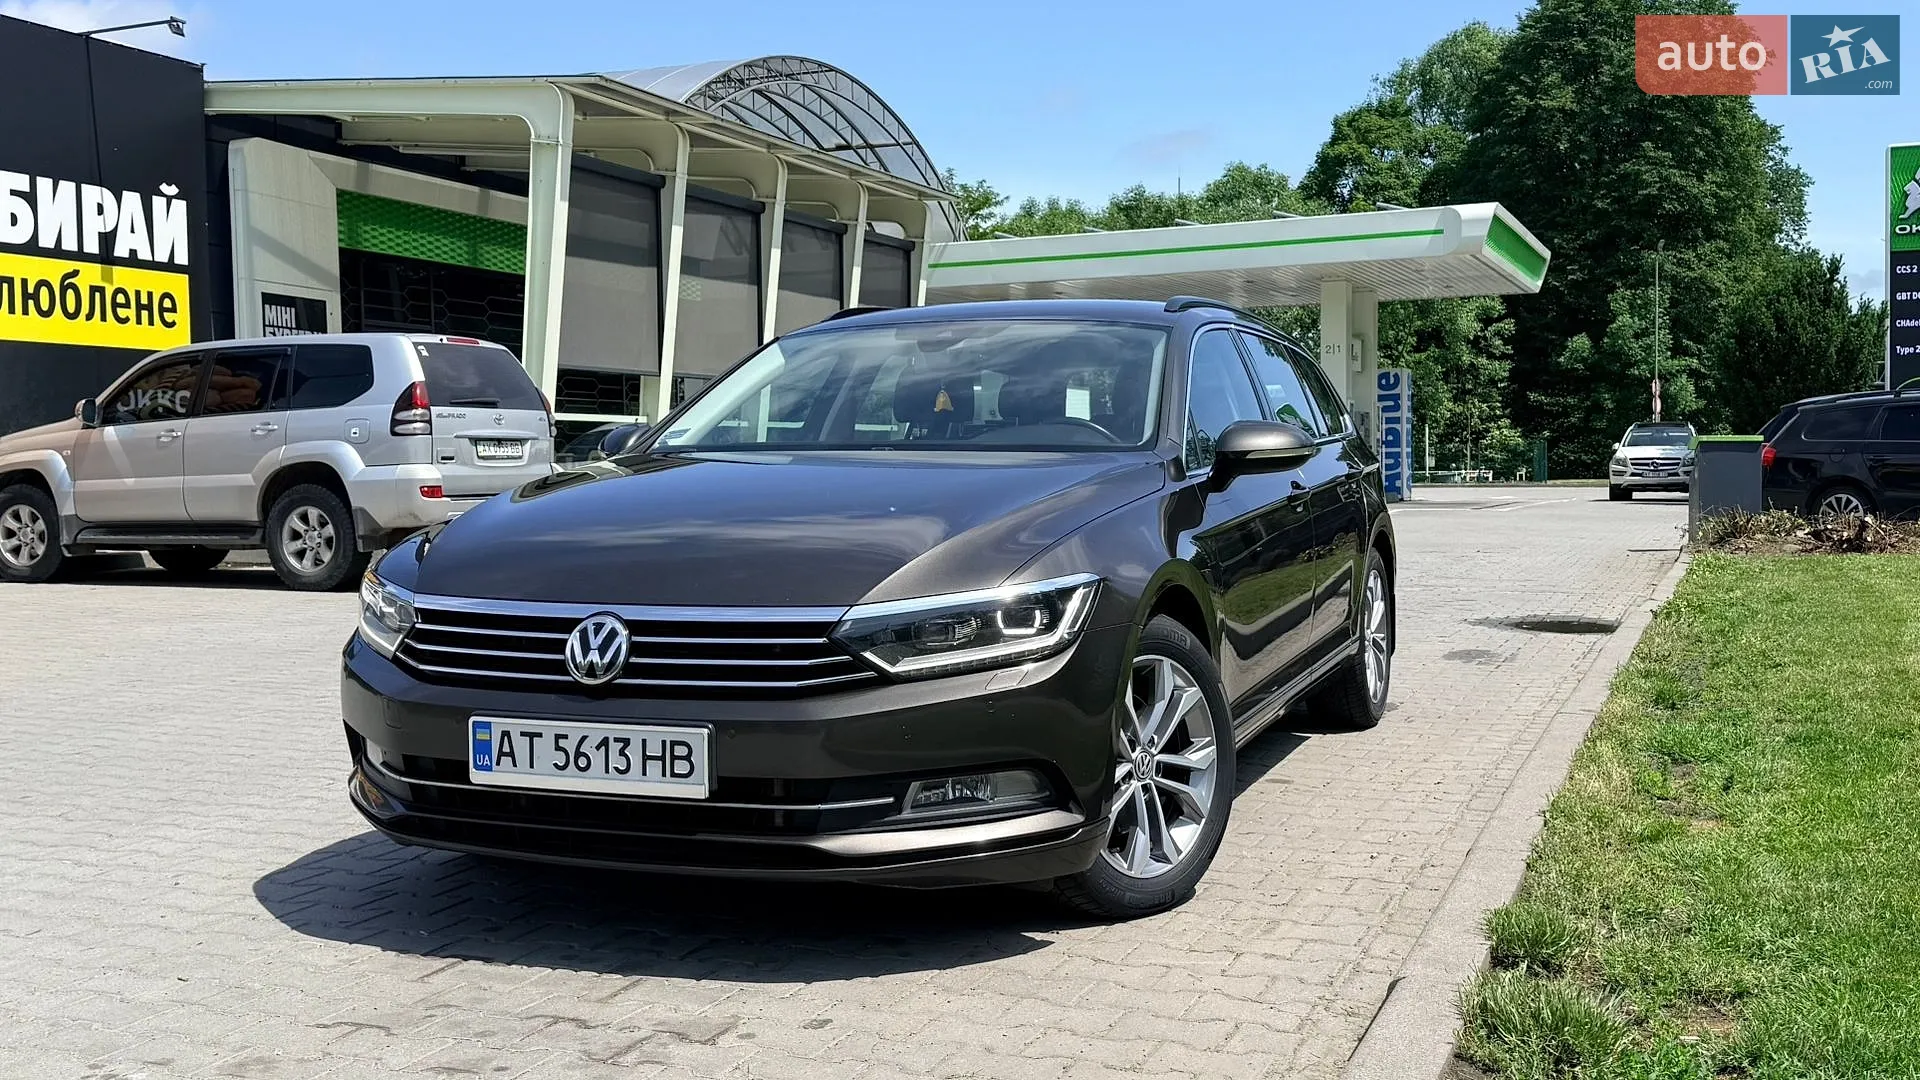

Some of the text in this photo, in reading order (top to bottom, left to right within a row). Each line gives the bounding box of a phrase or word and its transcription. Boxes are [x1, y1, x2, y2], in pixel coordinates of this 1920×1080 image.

[0, 170, 189, 266] БИРАЙ
[1896, 264, 1918, 274] CCS 2
[0, 269, 178, 329] люблене
[1896, 292, 1911, 301] GBT
[264, 304, 296, 328] МІНІ
[1896, 318, 1920, 328] CHAde
[1896, 345, 1914, 355] Type
[476, 754, 491, 766] UA
[495, 730, 696, 779] AT 5613 HB
